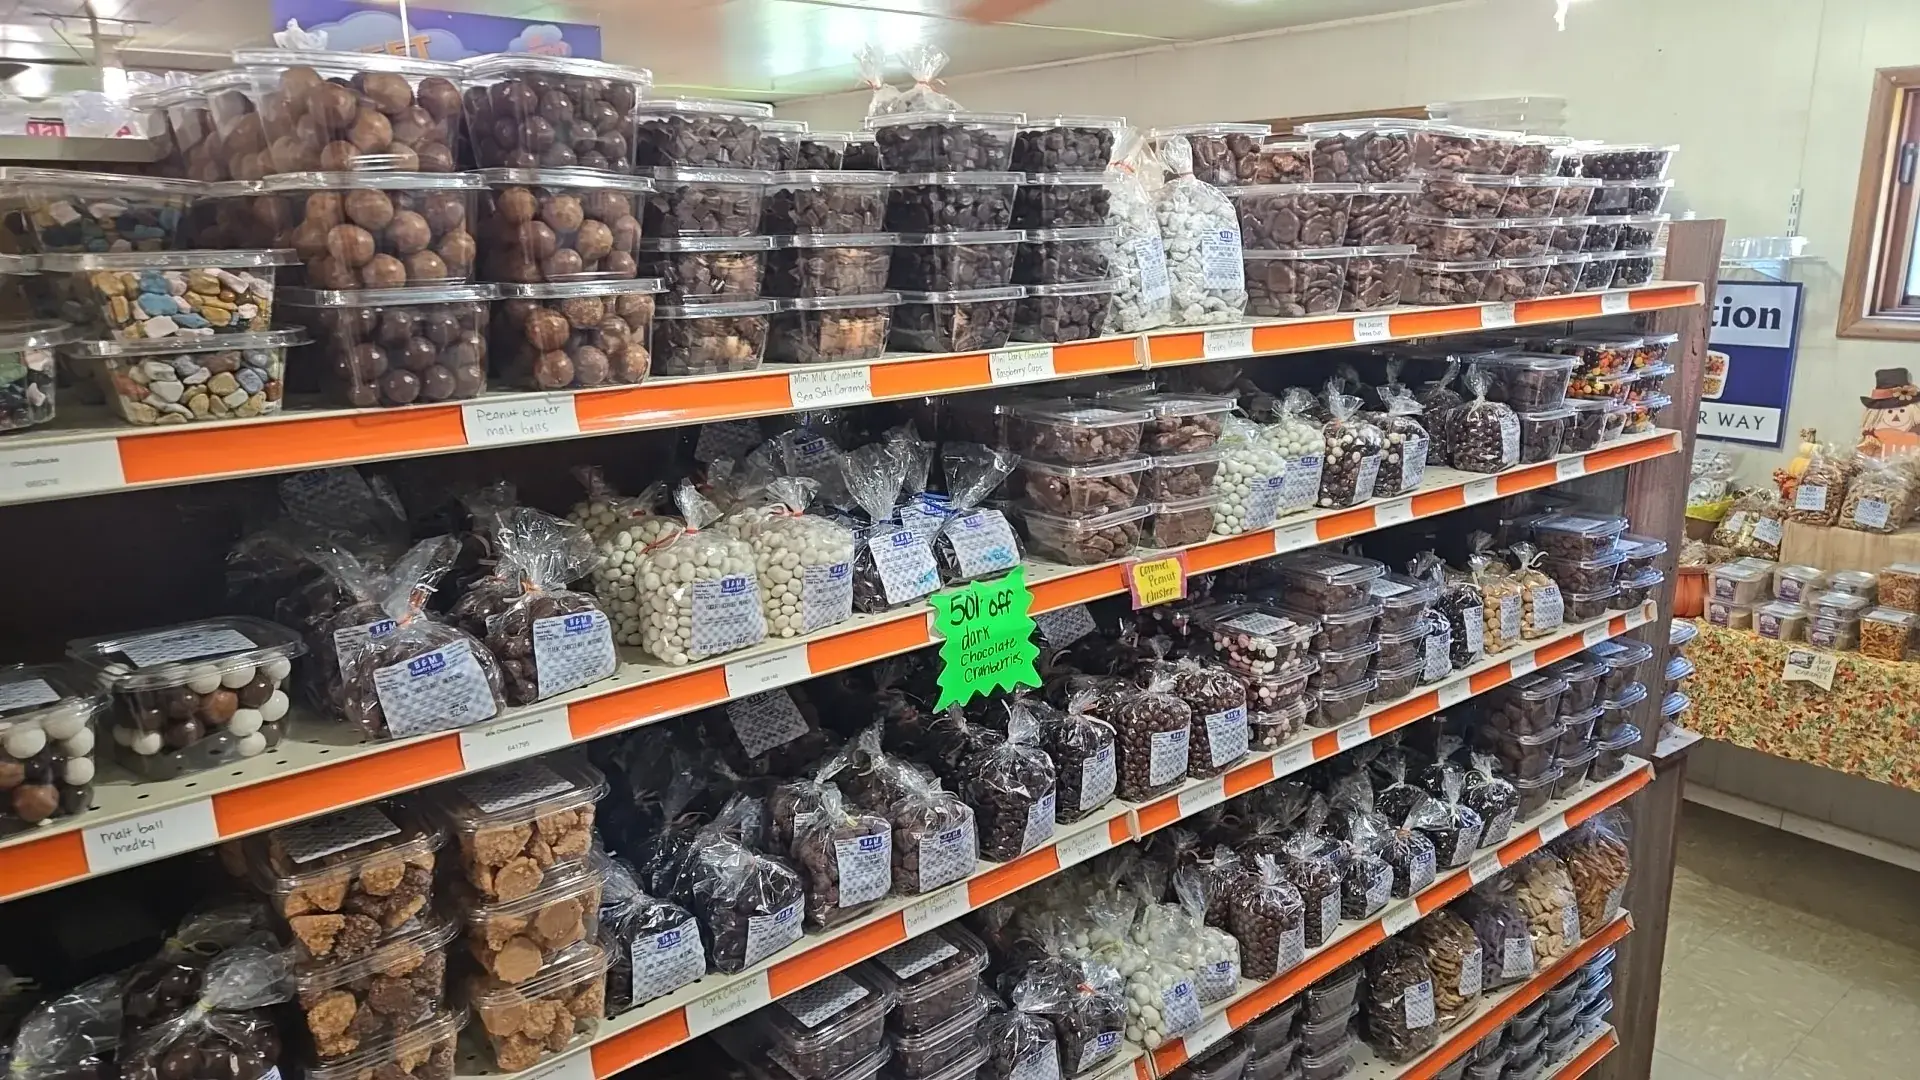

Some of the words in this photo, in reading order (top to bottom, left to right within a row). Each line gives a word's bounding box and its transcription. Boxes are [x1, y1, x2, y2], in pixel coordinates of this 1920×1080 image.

[1007, 352, 1023, 361] Dark
[794, 374, 809, 385] Mini
[811, 371, 827, 384] Milk
[830, 369, 863, 382] Chocolate
[1027, 363, 1043, 376] Cups
[796, 391, 813, 403] Sea
[815, 386, 832, 399] Salt
[834, 380, 871, 396] Caramels
[476, 409, 518, 423] Peanut
[522, 406, 560, 418] butter
[1718, 411, 1766, 430] WAY
[486, 425, 514, 437] malt
[520, 422, 549, 435] balls
[1139, 560, 1169, 577] Caramel
[1149, 571, 1176, 587] Peanut
[988, 590, 1014, 617] off
[961, 625, 990, 650] dark
[100, 827, 132, 844] malt
[136, 819, 164, 834] ball
[113, 837, 155, 855] medley
[722, 978, 757, 999] Chocolate
